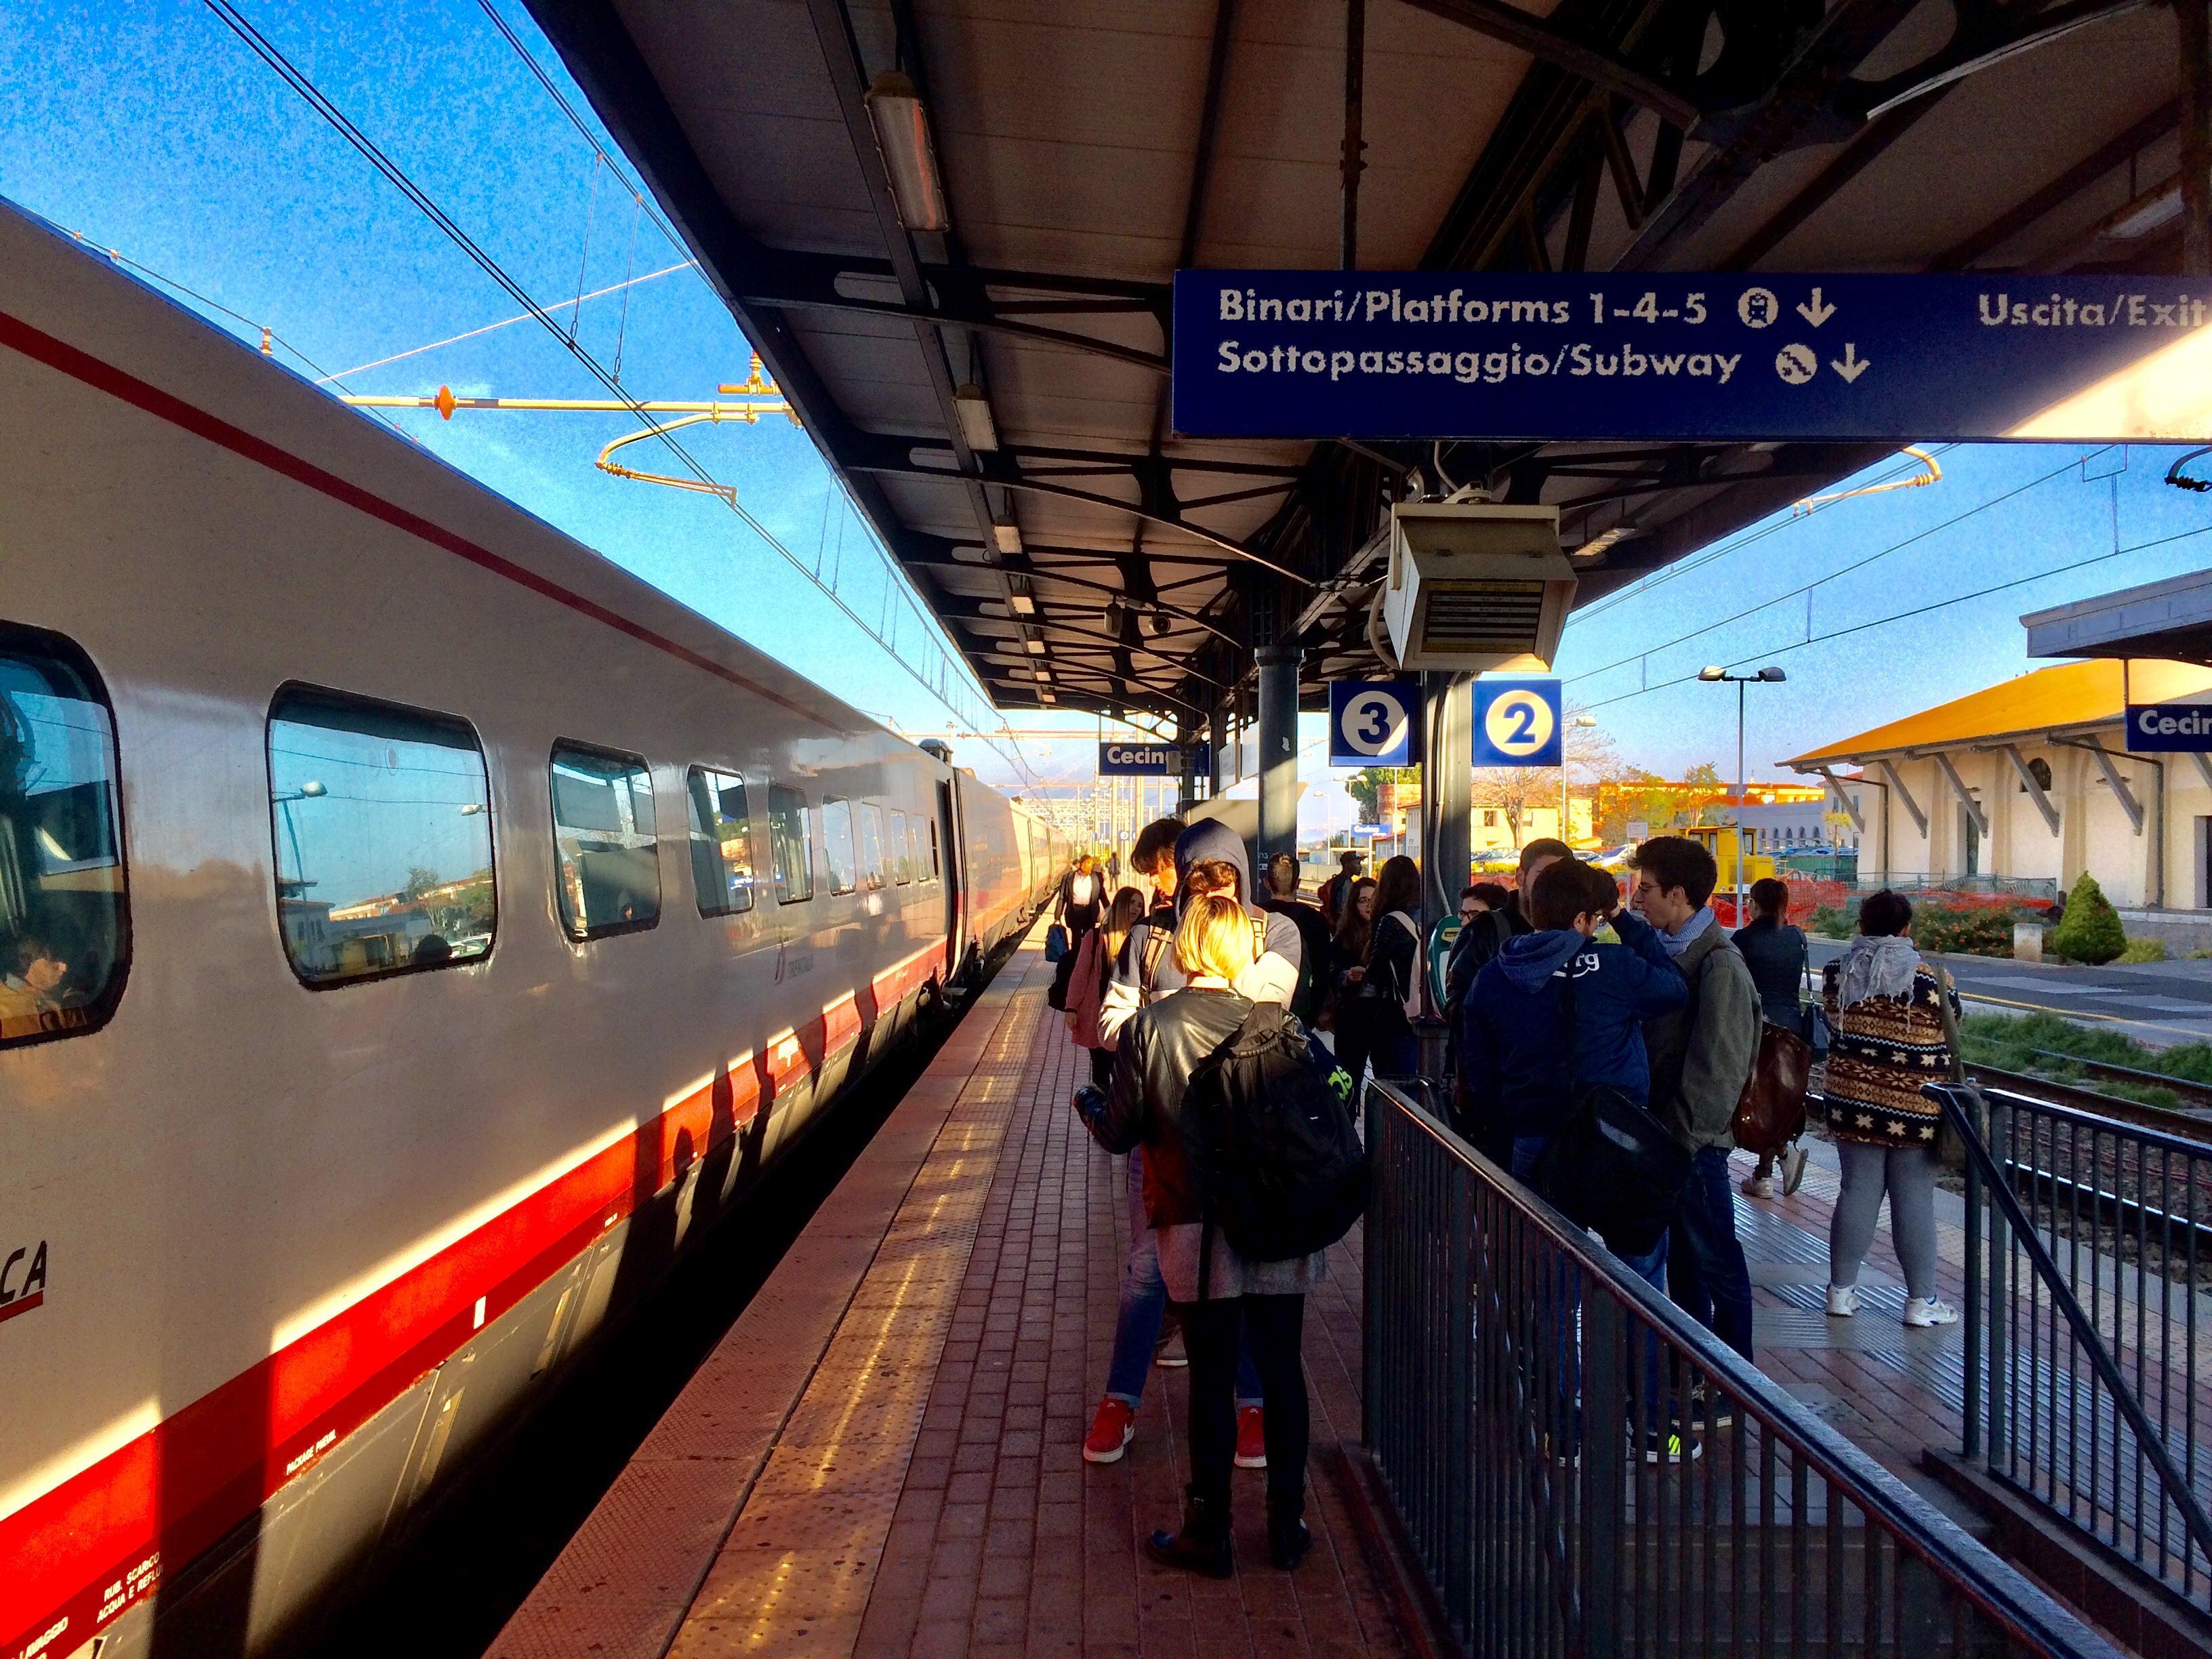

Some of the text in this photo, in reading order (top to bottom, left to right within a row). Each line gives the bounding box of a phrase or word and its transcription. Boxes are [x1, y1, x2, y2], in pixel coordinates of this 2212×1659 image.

[1220, 289, 1707, 325] Binari/Platforms 1-4-5
[1979, 293, 2207, 326] Uscita/Exit
[1218, 340, 1742, 385] Sottopassaggio/Subway
[1358, 701, 1390, 744] 3
[1502, 701, 1536, 744] 2
[1107, 746, 1167, 764] Cecin
[104, 1551, 160, 1602] RUB. SCARICO
[97, 1593, 125, 1623] ACQUA
[128, 1585, 135, 1599] E
